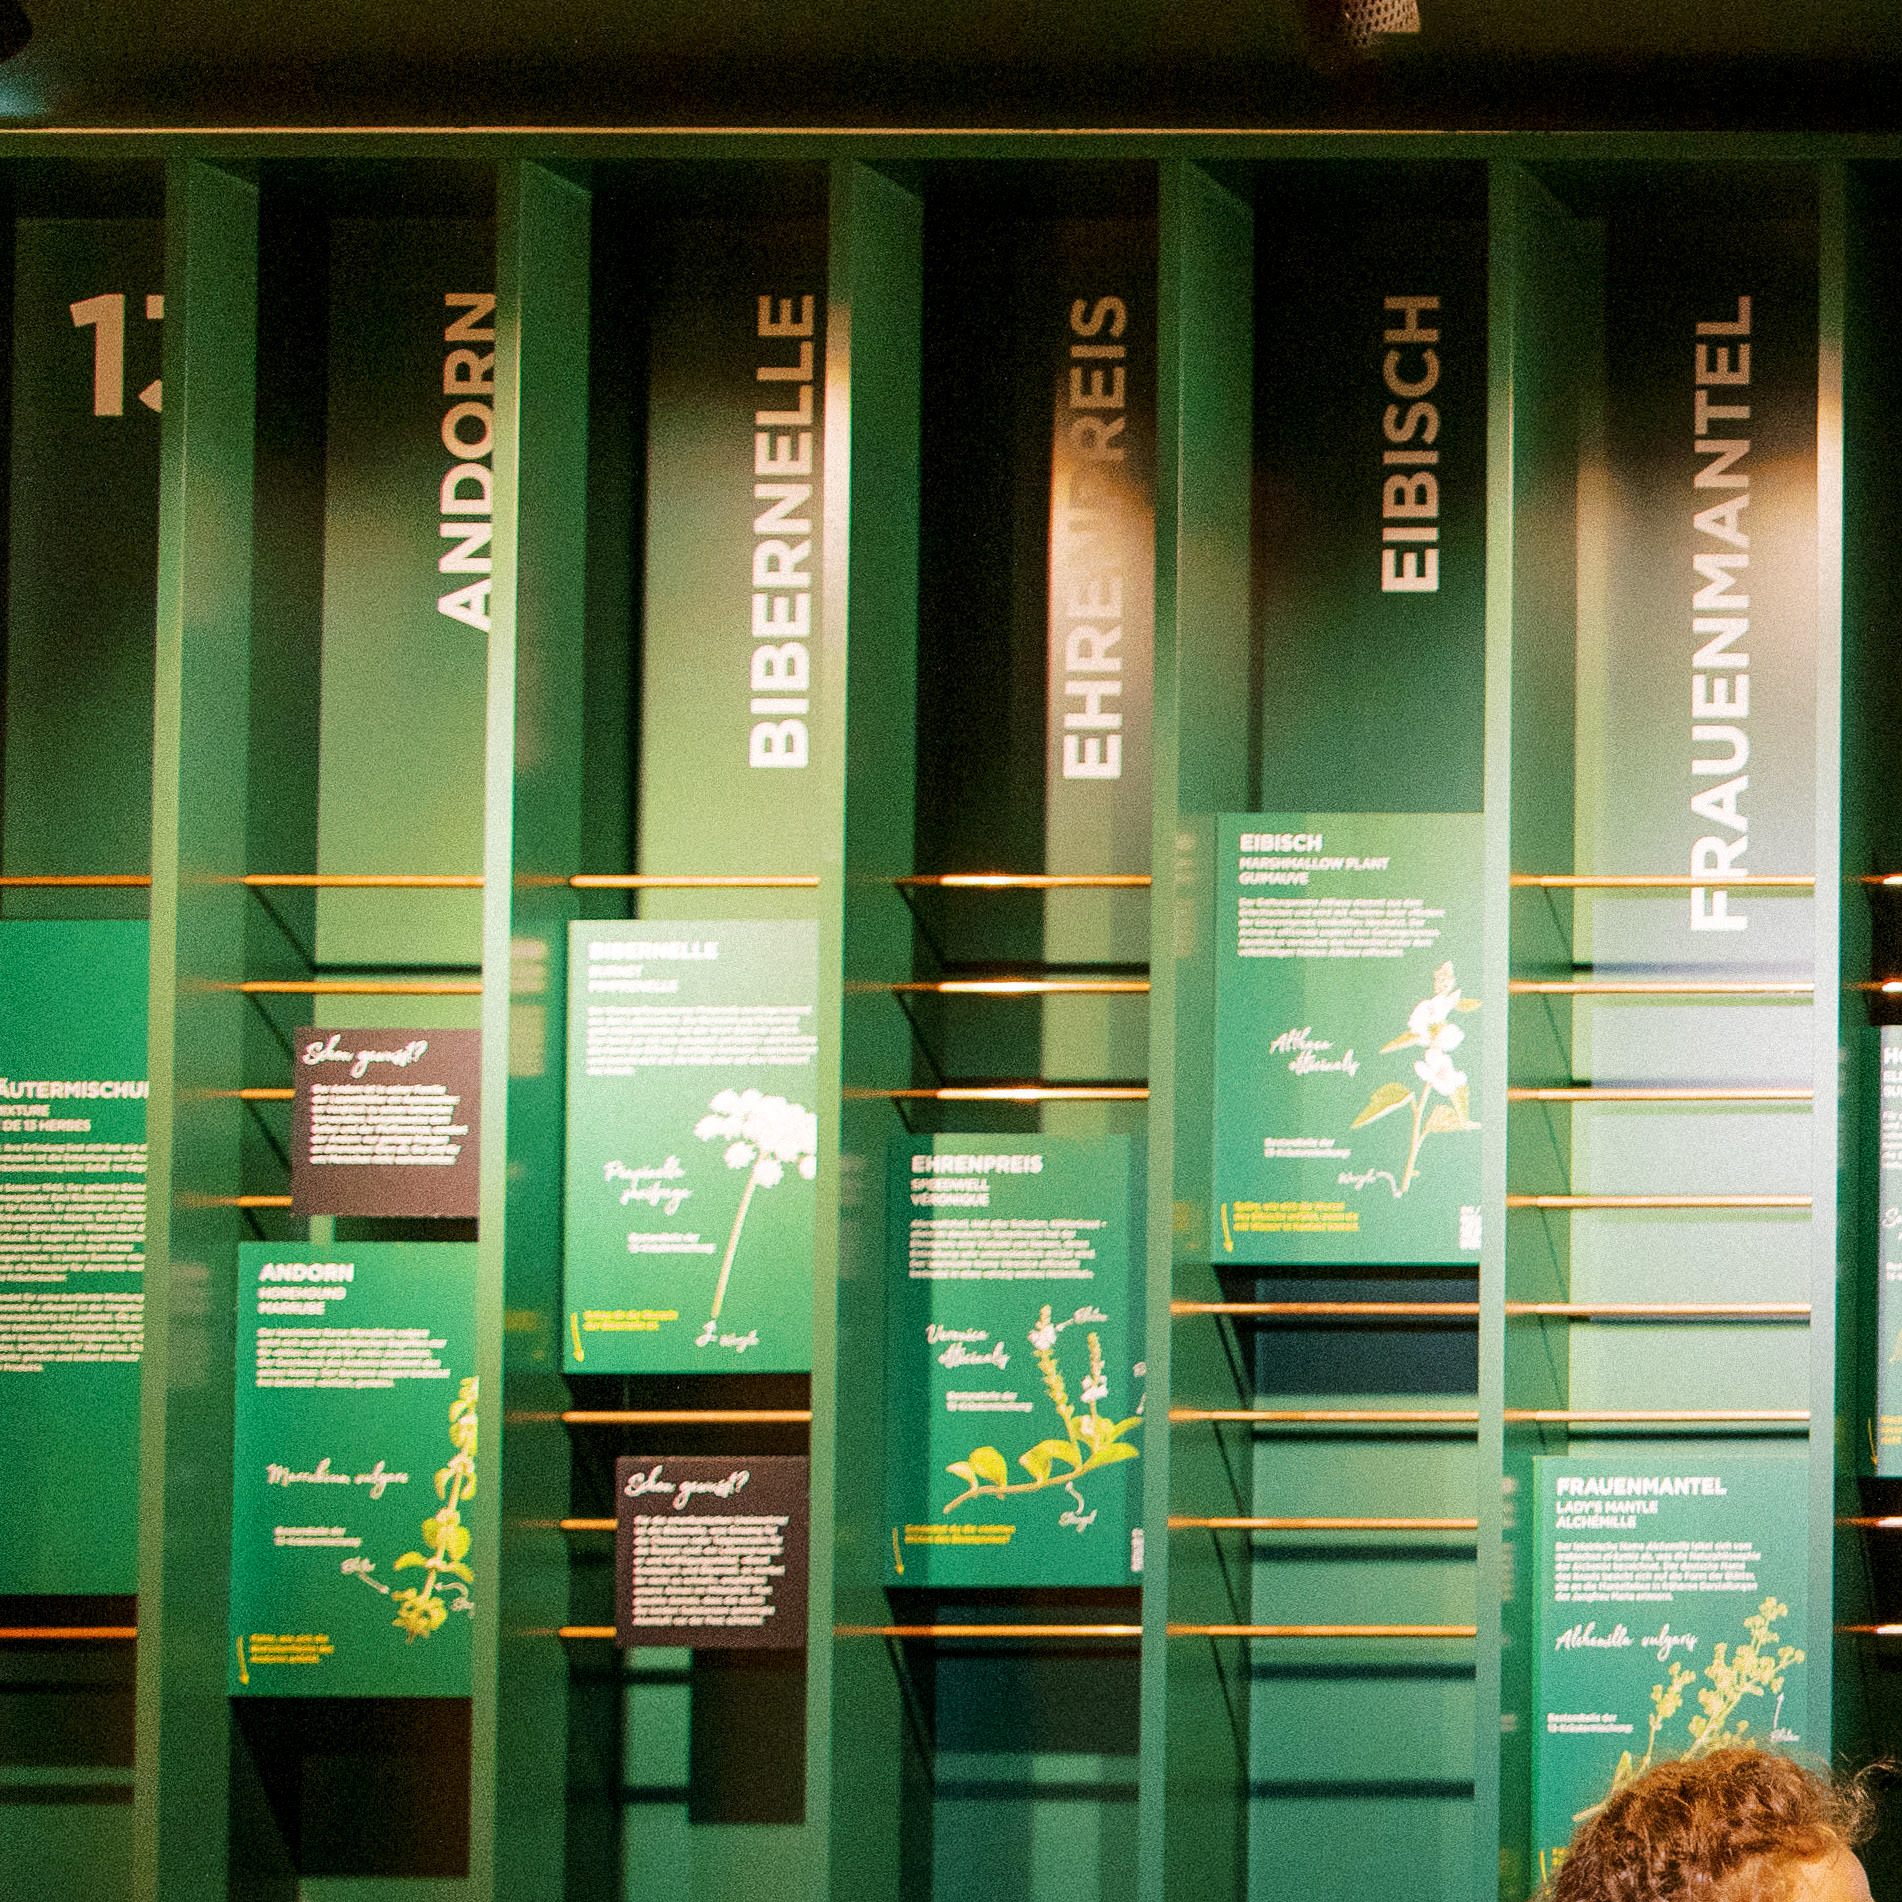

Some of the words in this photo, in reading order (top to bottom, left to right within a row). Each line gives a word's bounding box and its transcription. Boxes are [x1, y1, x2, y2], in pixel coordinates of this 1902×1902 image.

[70, 292, 163, 416] 1
[438, 292, 496, 632] ANDORN
[1381, 295, 1440, 594] EIBISCH
[748, 293, 816, 769] BIBERNELLE
[1063, 296, 1126, 779] EHREREIS
[1690, 295, 1752, 932] FRAUENMANTEL
[1239, 834, 1323, 852] EIBISCH
[911, 1155, 1043, 1174] EHRENPREIS
[259, 1263, 354, 1282] ANDORN
[1556, 1477, 1727, 1496] FRAUENMANTEL
[1604, 1501, 1658, 1514] MANTLE
